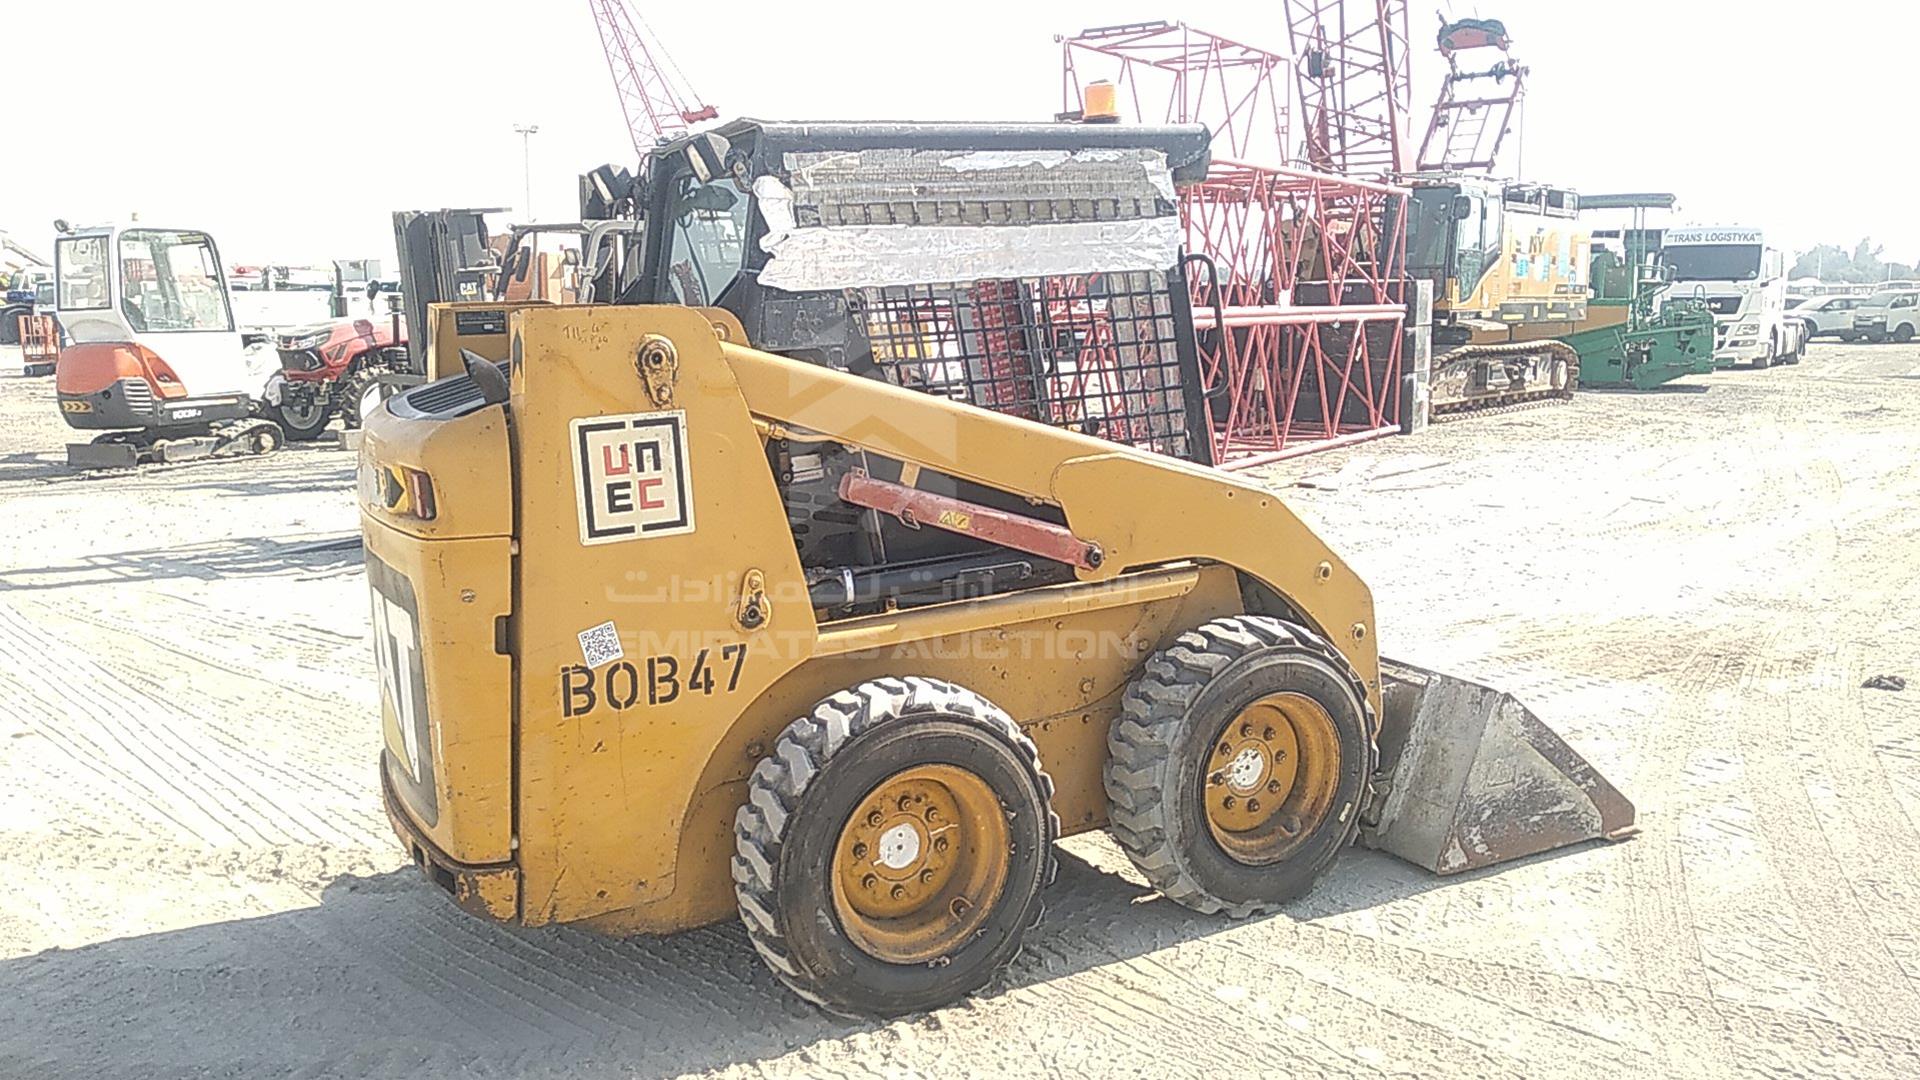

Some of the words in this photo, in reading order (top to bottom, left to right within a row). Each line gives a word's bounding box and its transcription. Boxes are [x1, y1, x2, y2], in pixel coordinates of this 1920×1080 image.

[1673, 233, 1702, 243] TRANS
[460, 282, 477, 295] CAT
[372, 585, 422, 785] AT
